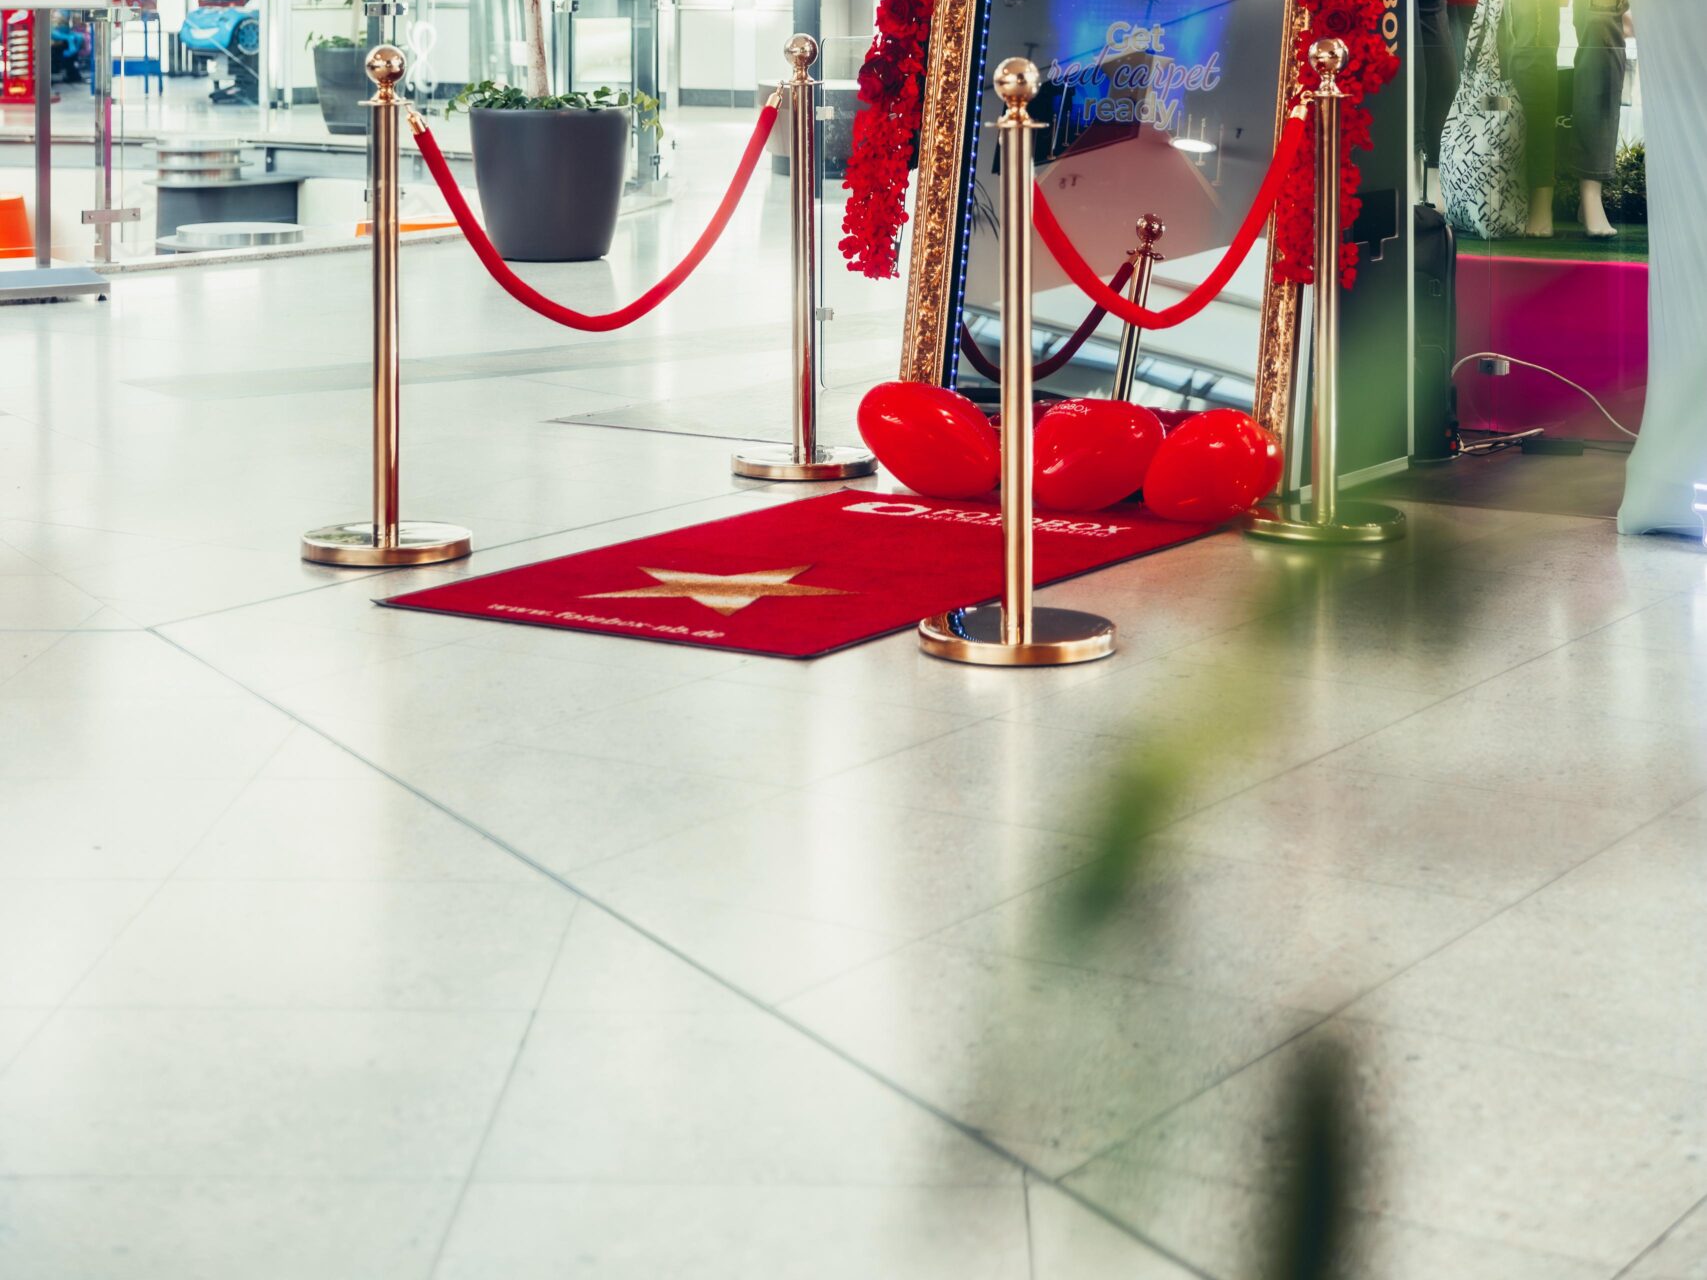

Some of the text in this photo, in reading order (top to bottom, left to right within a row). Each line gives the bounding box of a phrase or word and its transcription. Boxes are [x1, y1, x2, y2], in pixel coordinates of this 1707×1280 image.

[1106, 21, 1166, 52] Get
[1047, 44, 1221, 102] red carpet
[1083, 91, 1179, 131] ready
